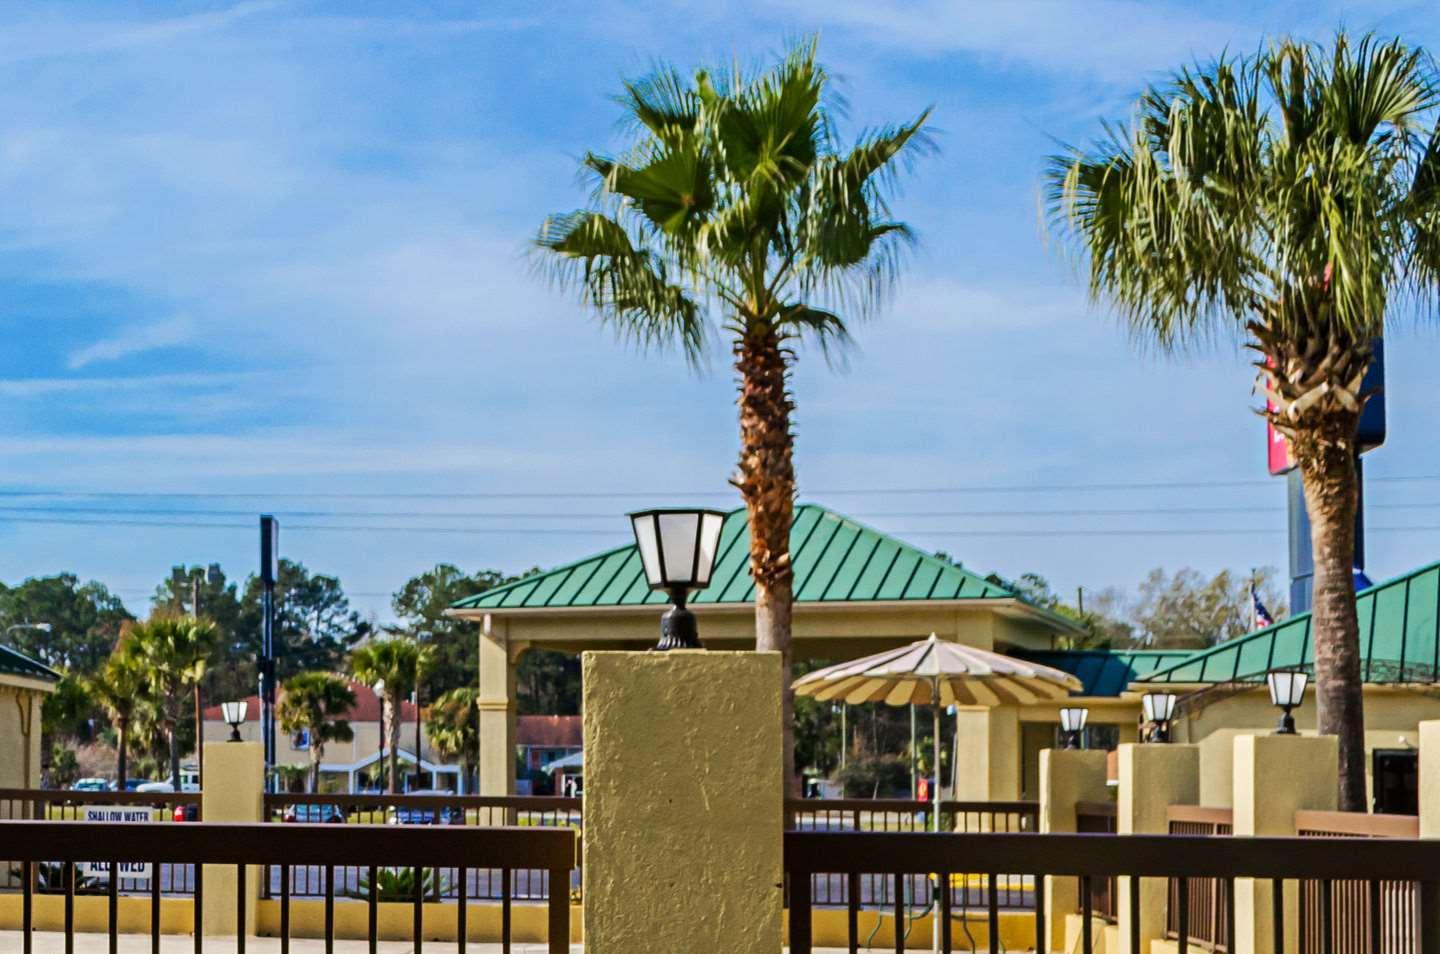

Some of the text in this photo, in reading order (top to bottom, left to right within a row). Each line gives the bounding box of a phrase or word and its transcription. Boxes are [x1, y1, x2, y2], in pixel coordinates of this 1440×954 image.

[87, 810, 149, 822] SHALLOW WATER
[90, 861, 145, 873] ALLWED
